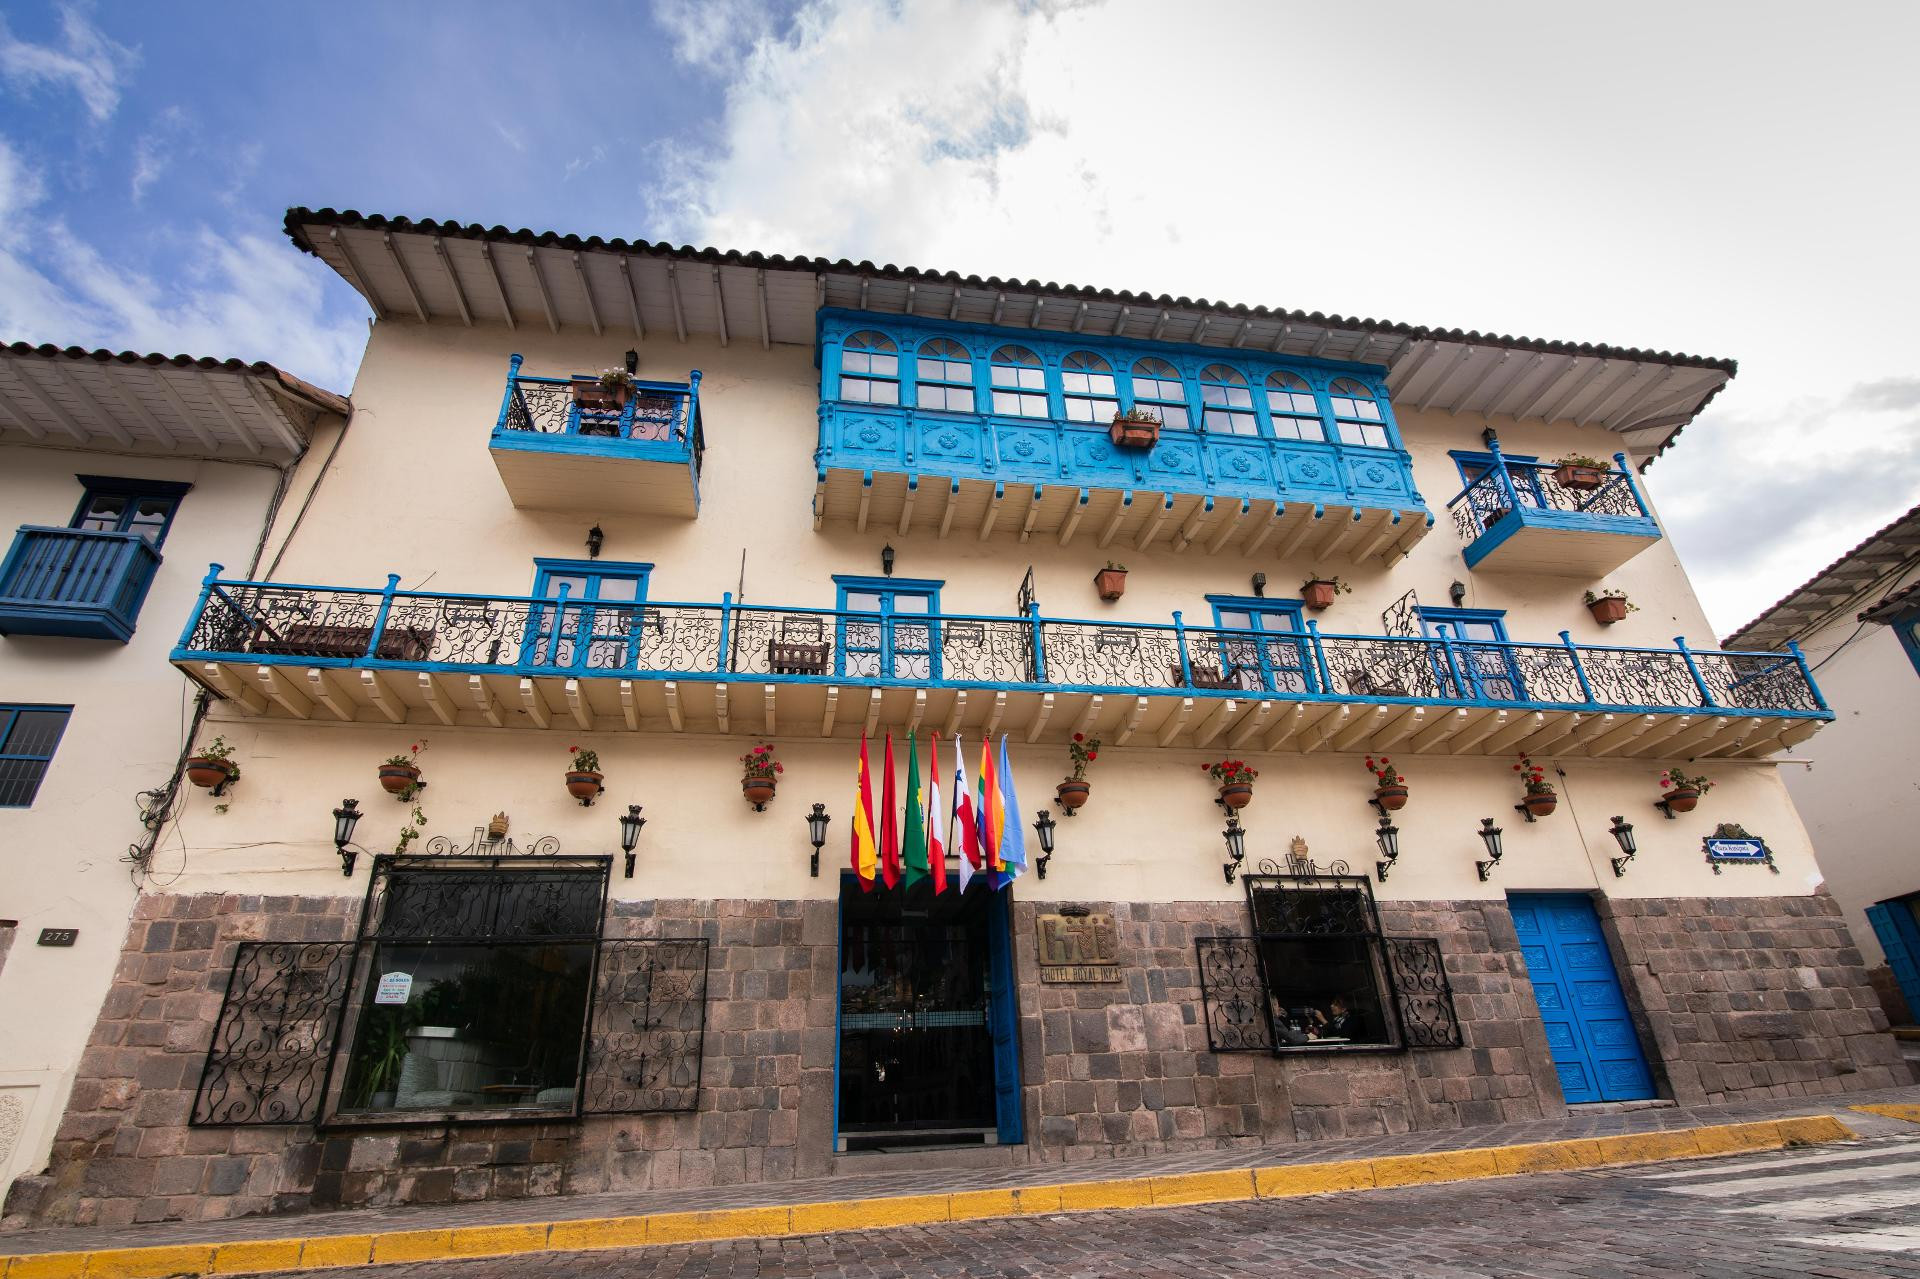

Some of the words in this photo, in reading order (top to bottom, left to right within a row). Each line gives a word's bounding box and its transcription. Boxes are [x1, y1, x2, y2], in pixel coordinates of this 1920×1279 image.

[44, 932, 70, 941] 275
[1044, 967, 1071, 981] HOTEL
[1072, 967, 1098, 981] ROYAL
